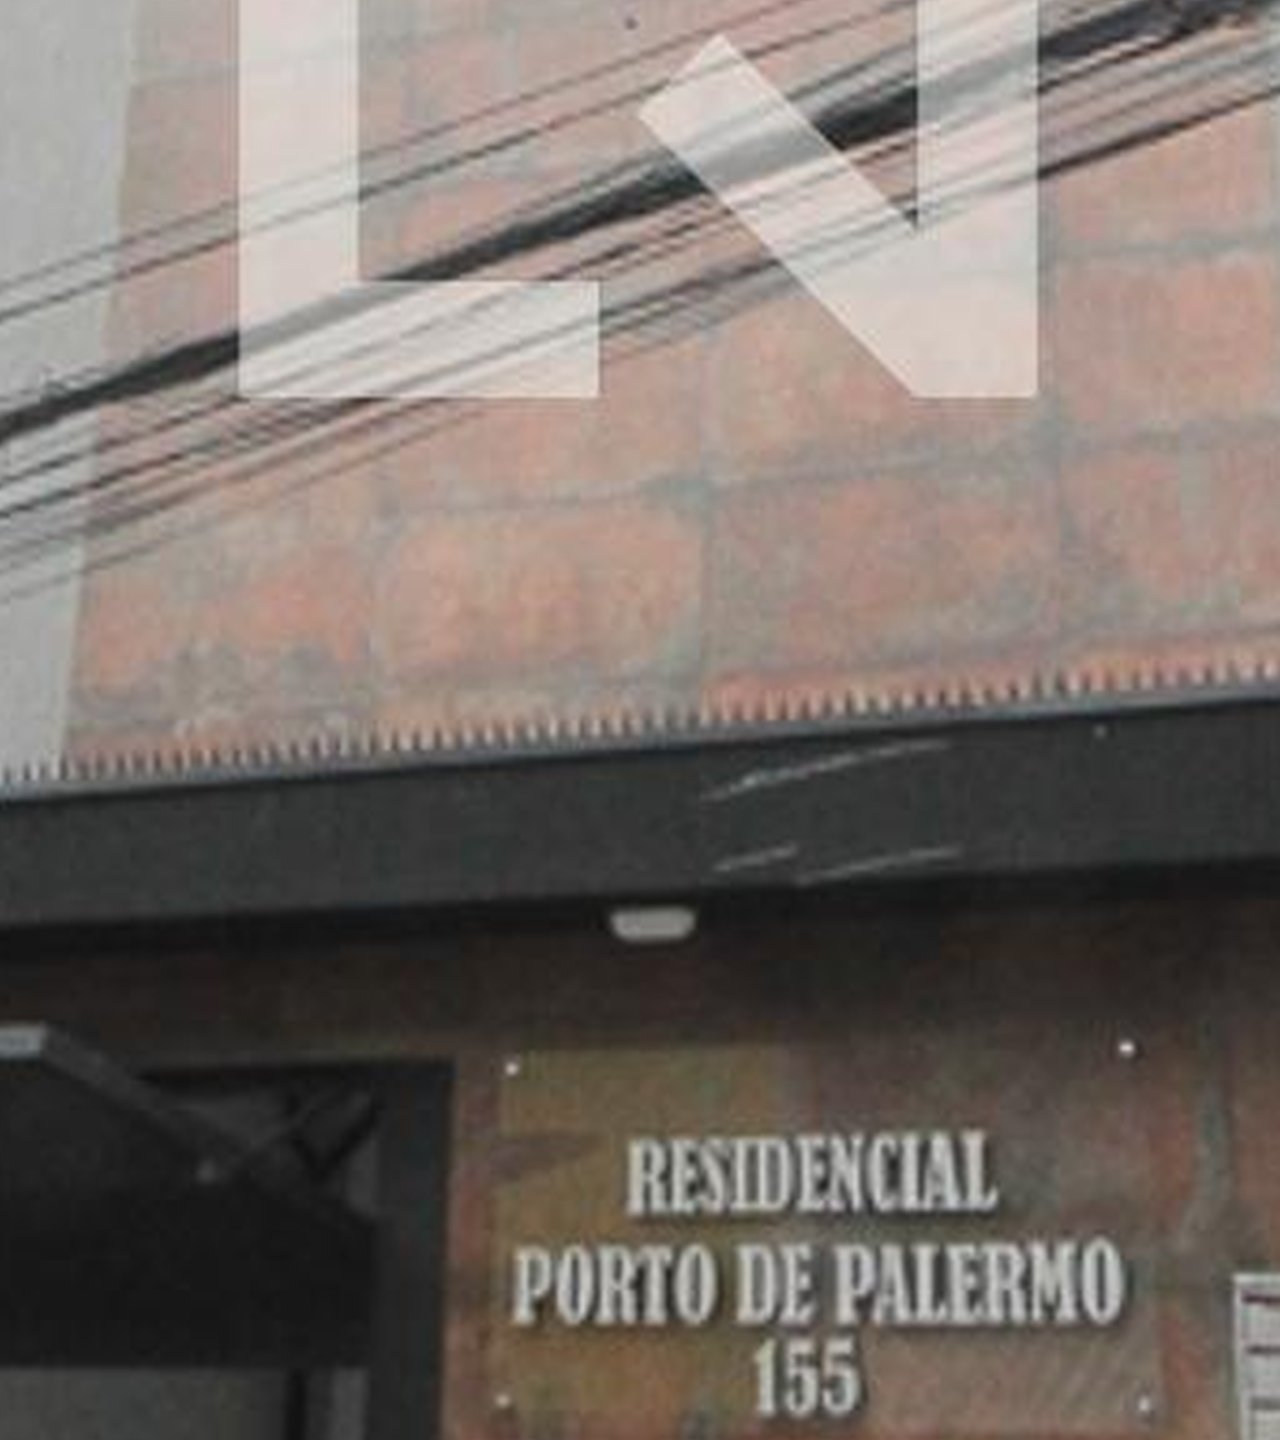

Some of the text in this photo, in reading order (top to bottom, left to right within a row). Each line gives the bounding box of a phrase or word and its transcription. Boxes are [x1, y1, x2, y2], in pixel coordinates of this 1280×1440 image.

[630, 1129, 997, 1214] RESIDENCIAL
[514, 1237, 1125, 1325] PORTO DE PALERMO
[754, 1337, 861, 1417] 155
